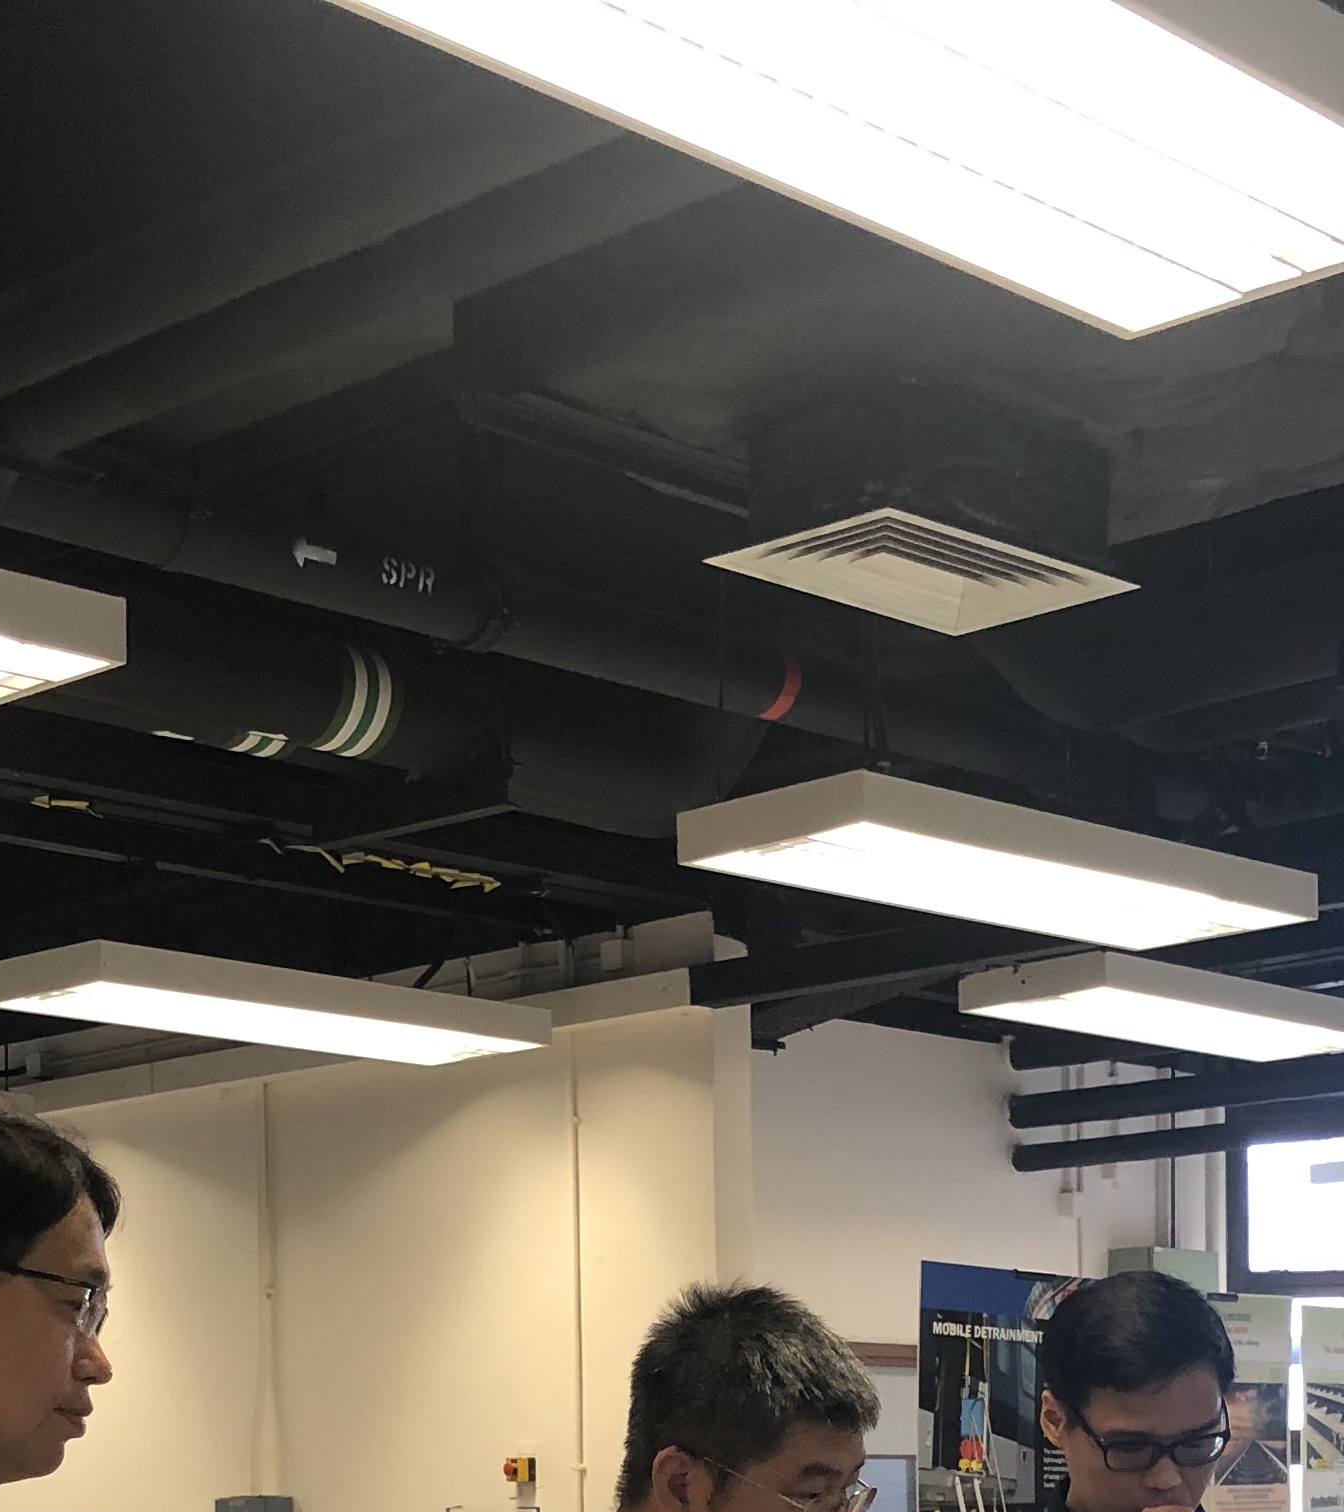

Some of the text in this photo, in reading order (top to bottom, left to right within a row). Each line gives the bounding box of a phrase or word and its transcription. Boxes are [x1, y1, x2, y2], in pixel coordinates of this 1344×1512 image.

[381, 556, 435, 596] SPR
[932, 1321, 1044, 1344] MOBILE DETRAINMENT
